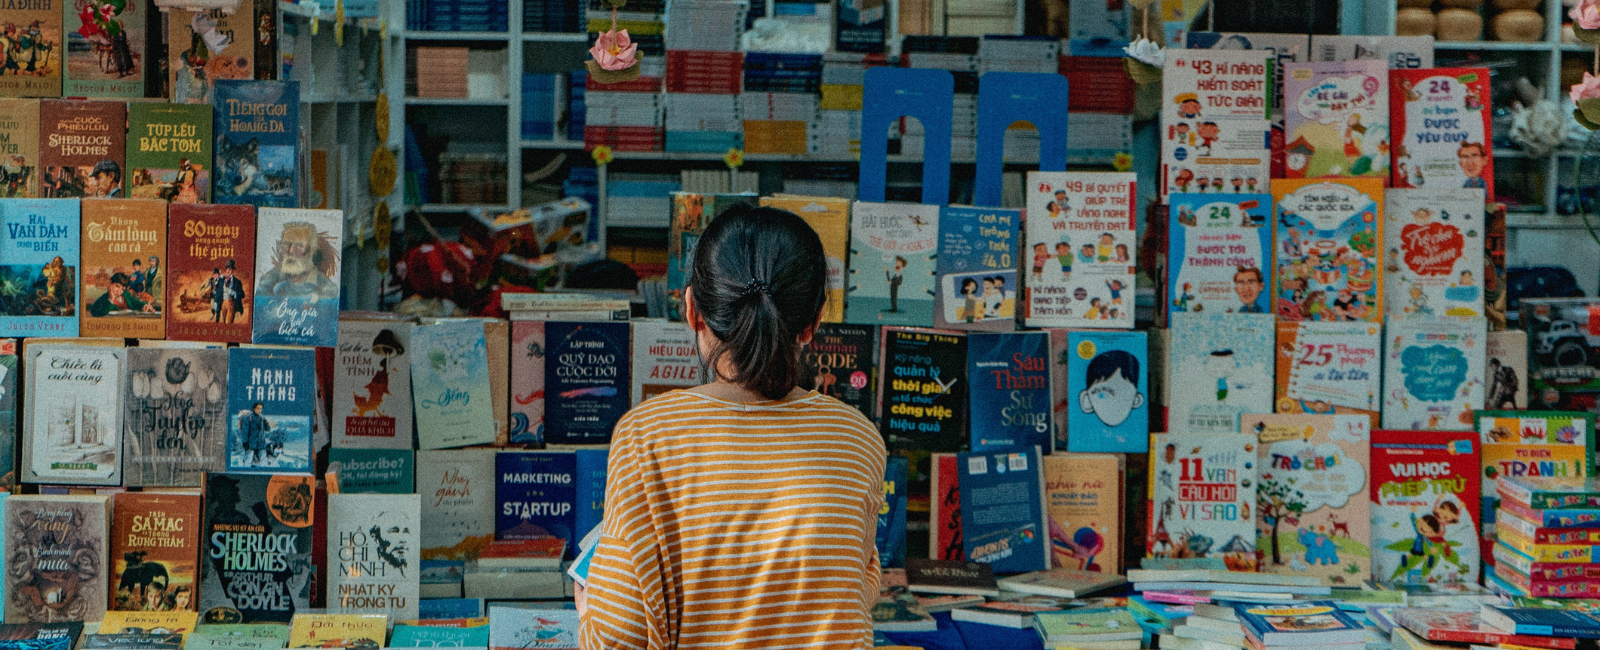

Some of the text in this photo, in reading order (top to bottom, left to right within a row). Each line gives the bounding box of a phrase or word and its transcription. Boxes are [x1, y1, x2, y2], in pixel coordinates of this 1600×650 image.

[1191, 59, 1213, 75] 43
[1429, 80, 1451, 93] 24
[230, 118, 269, 132] HOANG
[49, 133, 112, 147] SHERLOCK
[61, 145, 108, 156] HOLMES
[1066, 181, 1083, 193] 49
[28, 214, 46, 225] HAI
[1209, 206, 1231, 219] 24
[184, 219, 207, 238] 80
[824, 335, 843, 344] THE
[896, 332, 959, 344] The Big Thing
[805, 352, 858, 369] CODE
[1297, 344, 1335, 367] 25
[252, 367, 294, 386] NANH
[650, 365, 699, 380] AGILE
[851, 376, 868, 389] 20
[1178, 457, 1204, 482] 11
[1389, 463, 1417, 478] VUI
[1498, 459, 1568, 478] TRANH
[503, 473, 572, 484] MARKETING
[503, 501, 572, 520] STARTUP
[1201, 502, 1237, 521] SAO
[131, 514, 152, 533] SA
[210, 532, 298, 559] SHERLOCK
[223, 551, 288, 572] HOLMES
[338, 561, 386, 577] MINH
[232, 571, 274, 583] ARTHUR
[237, 595, 291, 611] DOYLE
[338, 597, 386, 609] TRONG
